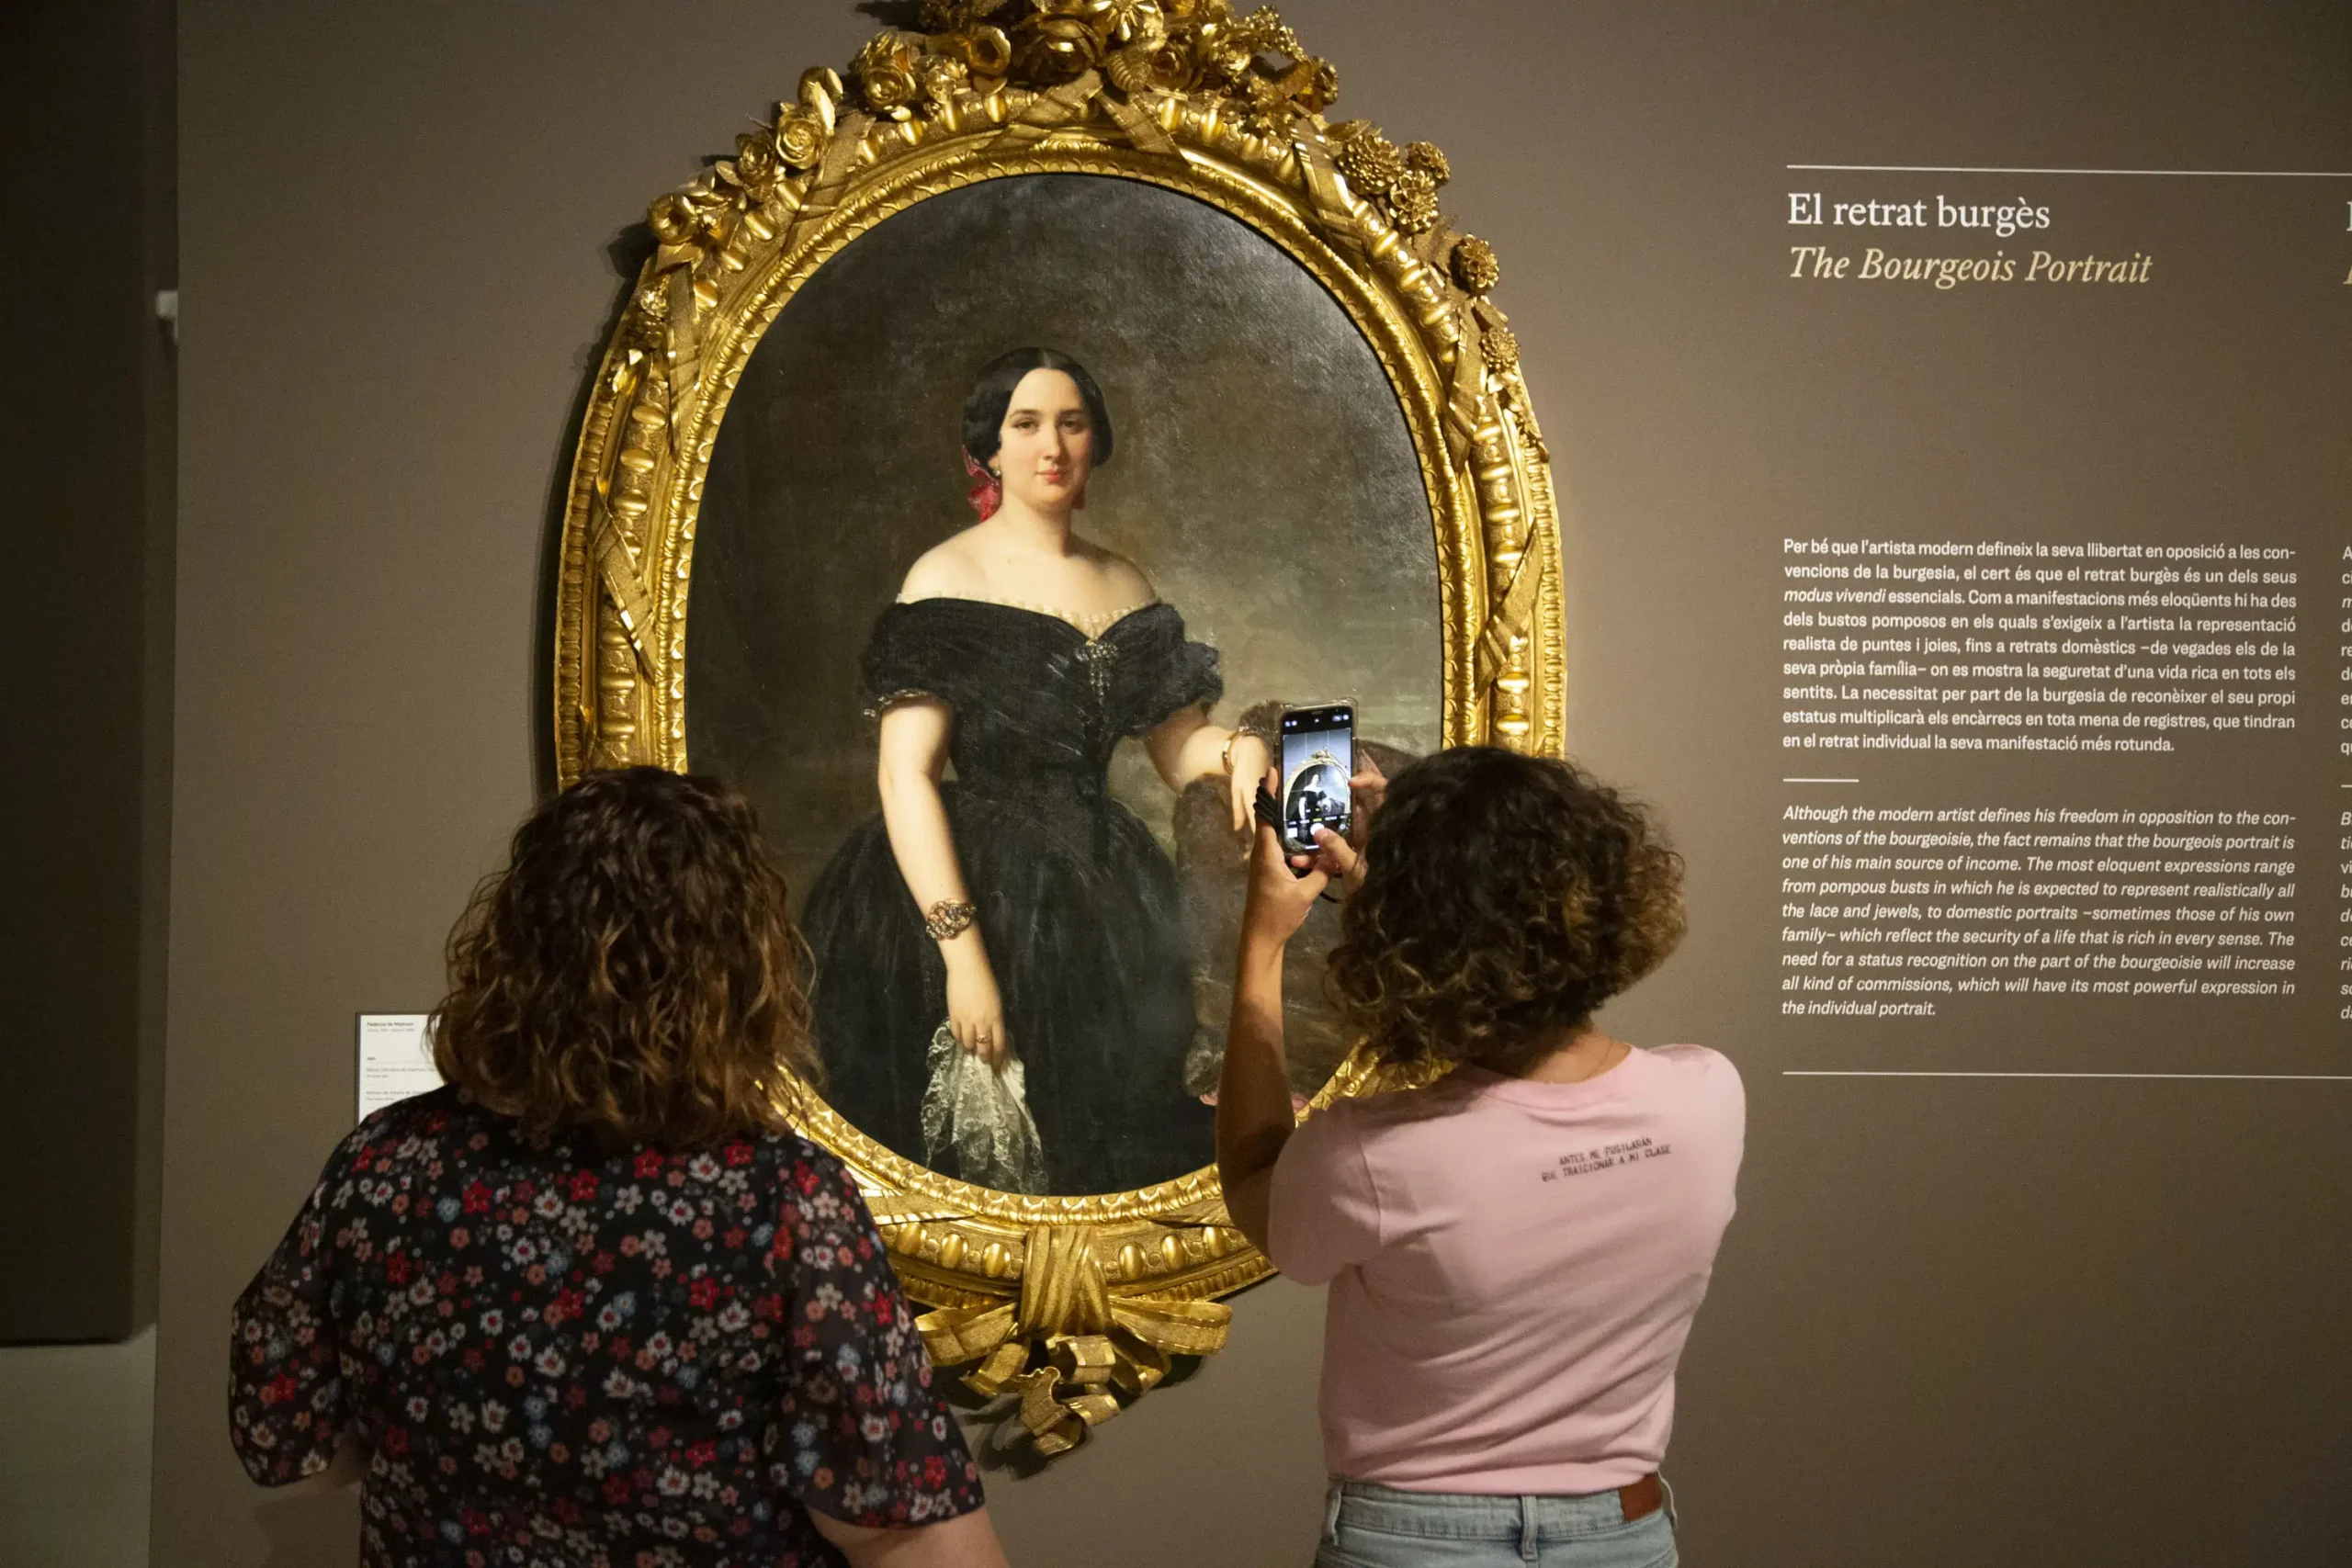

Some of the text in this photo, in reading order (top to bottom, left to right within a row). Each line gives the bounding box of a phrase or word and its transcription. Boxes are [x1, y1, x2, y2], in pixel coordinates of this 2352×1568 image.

[1787, 192, 2051, 238] El retrat burgès
[1790, 245, 2154, 290] The Bourgeois Portrait
[1783, 537, 1809, 554] Per
[1811, 536, 1829, 554] bé
[1831, 542, 1859, 558] que
[1918, 540, 1973, 557] modern
[1976, 540, 2033, 558] defineix
[2036, 541, 2049, 558] la
[2051, 545, 2085, 558] seva
[2086, 542, 2143, 558] llibertat
[2145, 547, 2164, 558] en
[2165, 542, 2225, 561] oposició
[2228, 547, 2237, 559] a
[2240, 544, 2261, 559] les
[2263, 547, 2296, 560] con-
[1784, 563, 2297, 585] vencions de la burgesia, el cert és que el retrat burgès és un dels seus
[1783, 587, 2297, 610] modus vivendi essencials. Com a manifestacions més eloqüents hi ha des
[1782, 684, 2296, 707] sentits. La necessitat per part de la burgesia de reconèixer el seu propi
[1782, 708, 2295, 731] estatus multiplicarà els encàrrecs en tota mena de registres, que tindran
[1782, 732, 2175, 752] en el retrat individual la seva manifestació més rotunda.
[1782, 805, 2297, 827] Although the modern artist defines his freedom in opposition to the con-
[1781, 829, 2295, 852] ventions of the bourgeoisie, the fact remains that the bourgeois portrait is
[1781, 877, 2296, 900] from pompous busts in which he is expected to represent realistically all
[1781, 951, 2296, 972] need for a status recognition on the part of the bourgeoisie will increase
[1781, 975, 2296, 997] all kind of commissions, which will have its most powerful expression in
[1559, 1152, 1586, 1166] ANTES
[1563, 1156, 1614, 1177] TRAICIONAR
[1620, 1155, 1625, 1164] A
[1629, 1153, 1639, 1163] MI
